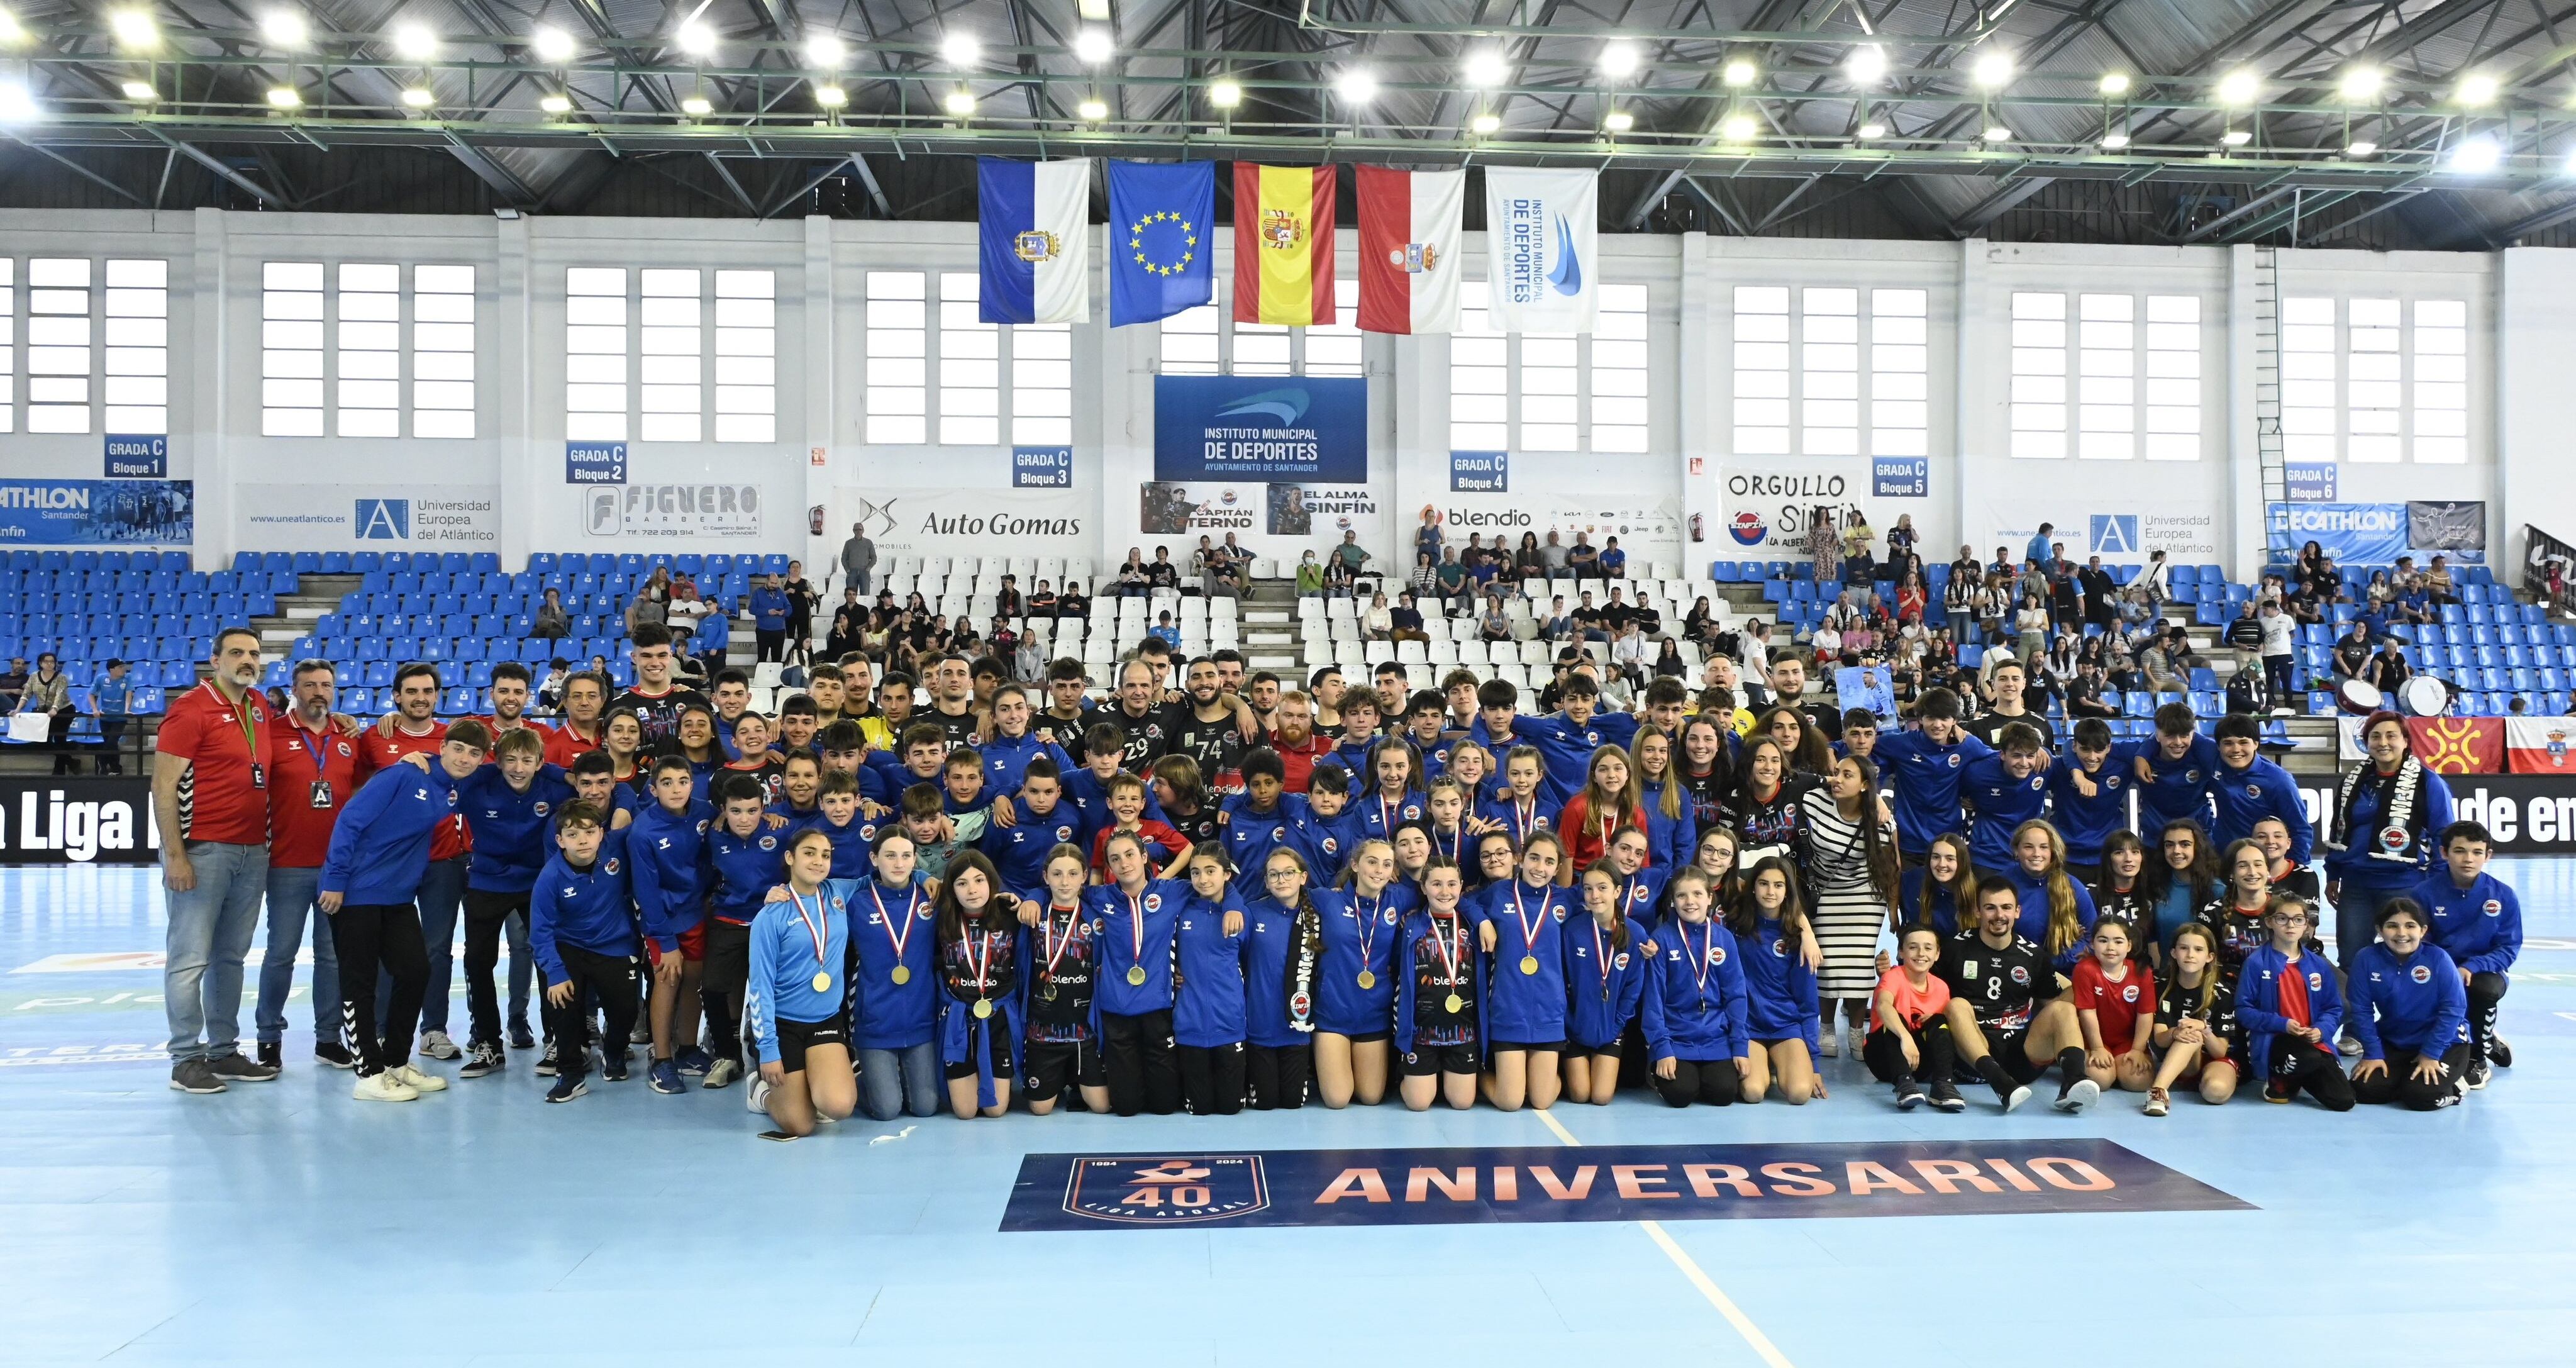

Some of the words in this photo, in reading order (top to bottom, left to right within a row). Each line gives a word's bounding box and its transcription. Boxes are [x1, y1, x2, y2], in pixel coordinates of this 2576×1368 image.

[1514, 199, 1529, 218] DE
[1533, 199, 1542, 248] INSTITUTO
[1514, 224, 1530, 303] DEPORTES
[1533, 252, 1543, 303] MUNICIPAL
[1205, 428, 1258, 439] INSTITUTO
[1262, 428, 1318, 440] MUNICIPAL
[109, 443, 148, 455] GRADA
[152, 440, 163, 456] C
[570, 450, 609, 462] GRADA
[613, 446, 623, 462] C
[1205, 442, 1226, 460] DE
[1231, 442, 1318, 461] DEPORTES
[1017, 454, 1055, 467] GRADA
[1058, 450, 1069, 467] C
[1455, 459, 1491, 471] GRADA
[1494, 455, 1504, 472] C
[113, 462, 148, 475] Bloque
[152, 459, 158, 474] 1
[575, 469, 609, 482] Bloque
[613, 465, 622, 480] 2
[1205, 463, 1261, 471] AYUNTAMIENTO
[1275, 464, 1318, 472] SANTANDER
[1877, 464, 1912, 476] GRADA
[1915, 461, 1924, 476] C
[2287, 469, 2321, 481] GRADA
[2324, 466, 2334, 481] C
[1021, 472, 1055, 485] Bloque
[1058, 470, 1067, 484] 3
[1458, 477, 1491, 491] Bloque
[1494, 474, 1503, 489] 4
[1728, 475, 1845, 497] ORGULLO
[1880, 482, 1912, 495] Bloque
[1915, 480, 1923, 494] 5
[2290, 487, 2322, 499] Bloque
[2324, 485, 2333, 499] 6
[1324, 491, 1368, 499] ALMA
[418, 499, 491, 511] Universidad
[1197, 508, 1253, 516] CAPITÁN
[1306, 501, 1376, 513] SINFÍN
[42, 511, 89, 519] Santander
[250, 514, 345, 524] www.uneatlantico.es
[418, 514, 471, 527] Europea
[1449, 508, 1531, 526] blendio
[2145, 514, 2210, 526] Universidad
[2275, 511, 2396, 531] DECATHLON
[0, 525, 26, 537] nfin
[921, 512, 984, 535] Auto
[989, 513, 1080, 536] Gomas
[418, 529, 436, 540] del
[440, 528, 494, 540] Atlántico
[2145, 528, 2192, 541] Europea
[2355, 532, 2396, 540] Santander
[2145, 543, 2163, 553] del
[2165, 543, 2213, 553] Atlántico
[1124, 737, 1149, 761] 29
[1196, 740, 1223, 761] 74
[255, 770, 262, 783] E
[315, 789, 328, 803] A
[1205, 784, 1236, 793] lendio
[21, 790, 134, 862] Liga
[960, 977, 997, 987] bledio
[1051, 974, 1087, 984] blendio
[1987, 976, 2002, 1000] 8
[1314, 1156, 2117, 1204] ANIVERSARIO
[1121, 1186, 1211, 1208] 40
[1084, 1202, 1136, 1216] LIGA
[1156, 1200, 1250, 1217] ASOBAL
